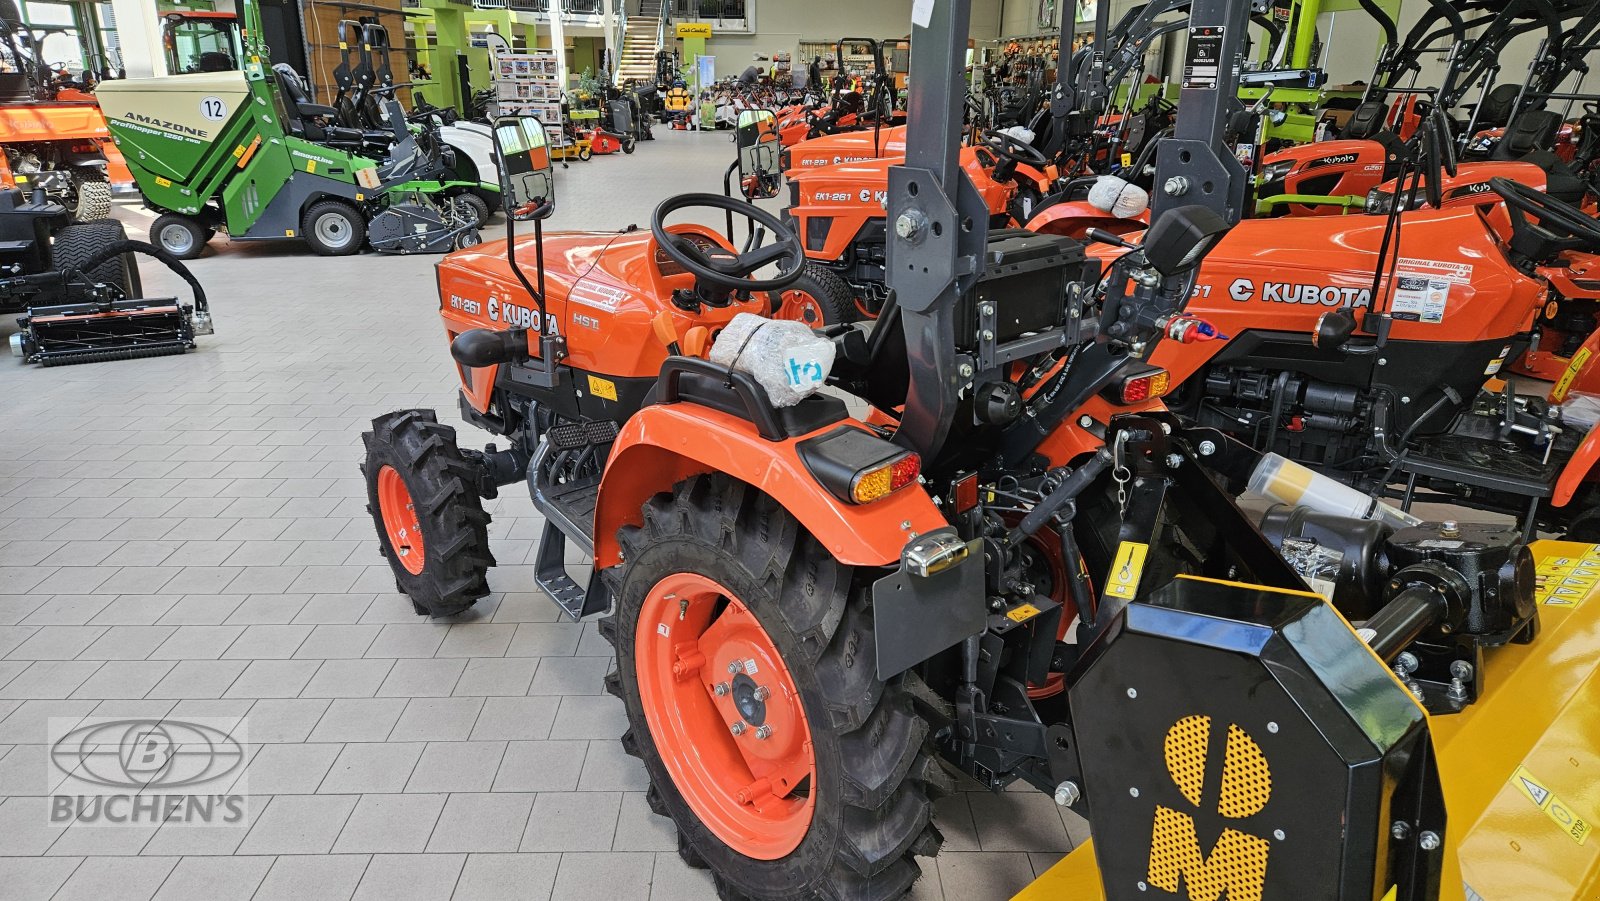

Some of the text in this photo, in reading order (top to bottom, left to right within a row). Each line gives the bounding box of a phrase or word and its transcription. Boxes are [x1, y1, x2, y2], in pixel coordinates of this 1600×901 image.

[204, 100, 222, 117] 12
[110, 119, 162, 136] Profihopper
[124, 112, 208, 138] AMAZONE
[292, 150, 334, 165] SmartLine
[1324, 154, 1354, 164] Kubota
[815, 192, 852, 201] EK1-261
[1398, 258, 1430, 266] ORIGINAL
[1262, 282, 1372, 308] KUBOTA
[450, 294, 481, 316] EK1-261
[1570, 820, 1584, 838] STOP
